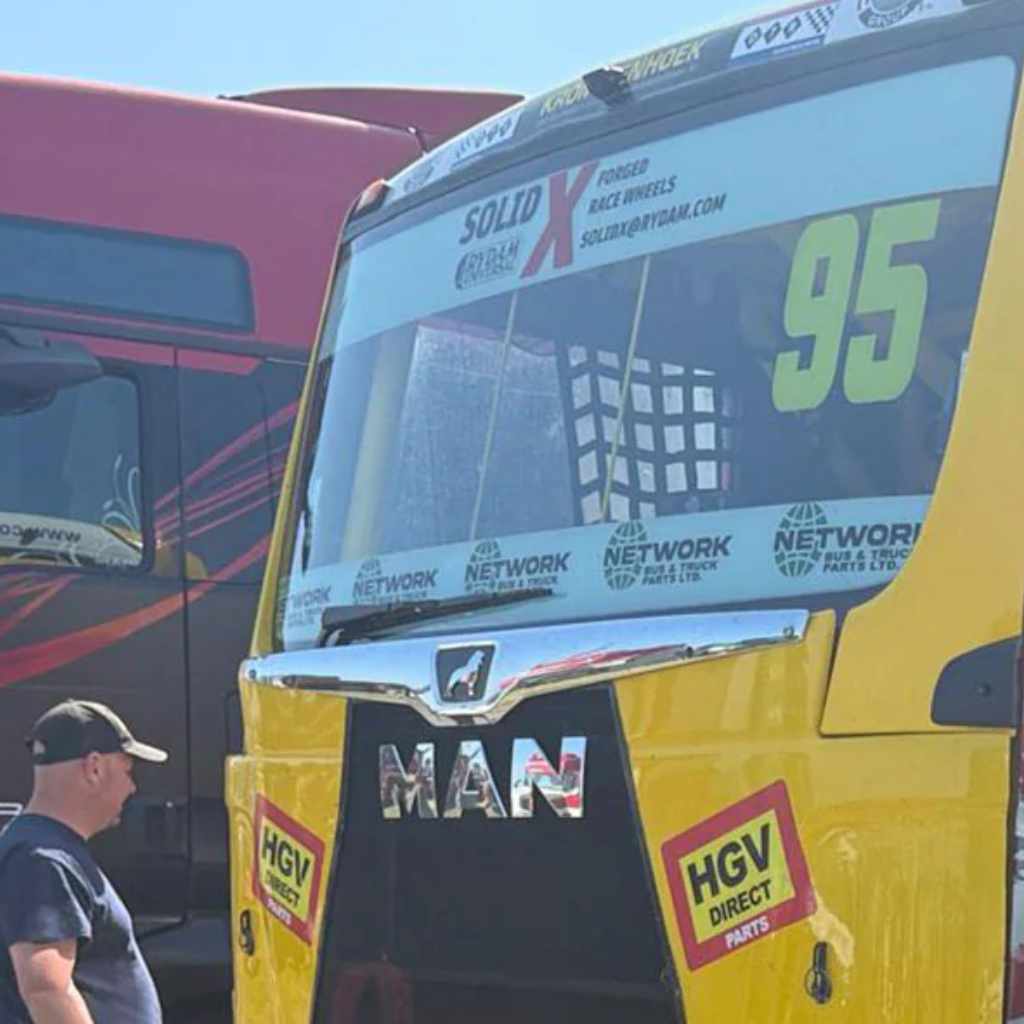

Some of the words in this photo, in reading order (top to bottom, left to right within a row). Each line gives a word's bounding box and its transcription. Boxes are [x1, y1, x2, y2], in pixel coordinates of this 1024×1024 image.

[597, 158, 650, 186] FORGED
[588, 190, 619, 215] RACE
[623, 176, 677, 205] WHEELS
[459, 185, 542, 245] SOLID
[771, 198, 941, 413] 95
[465, 552, 571, 582] NETWORK
[603, 535, 732, 566] NETWORK
[823, 561, 866, 573] PARTS
[824, 551, 851, 562] BUS
[352, 568, 440, 598] NETWORK
[641, 574, 676, 585] PARTS
[644, 564, 666, 576] BUS
[668, 564, 677, 574] &
[680, 561, 718, 573] TRUCK
[378, 736, 587, 820] MAN
[262, 825, 310, 888] HGV
[687, 822, 770, 906] HGV
[265, 870, 300, 908] DIRECT
[709, 878, 772, 928] DIRECT
[724, 915, 770, 950] PARTS
